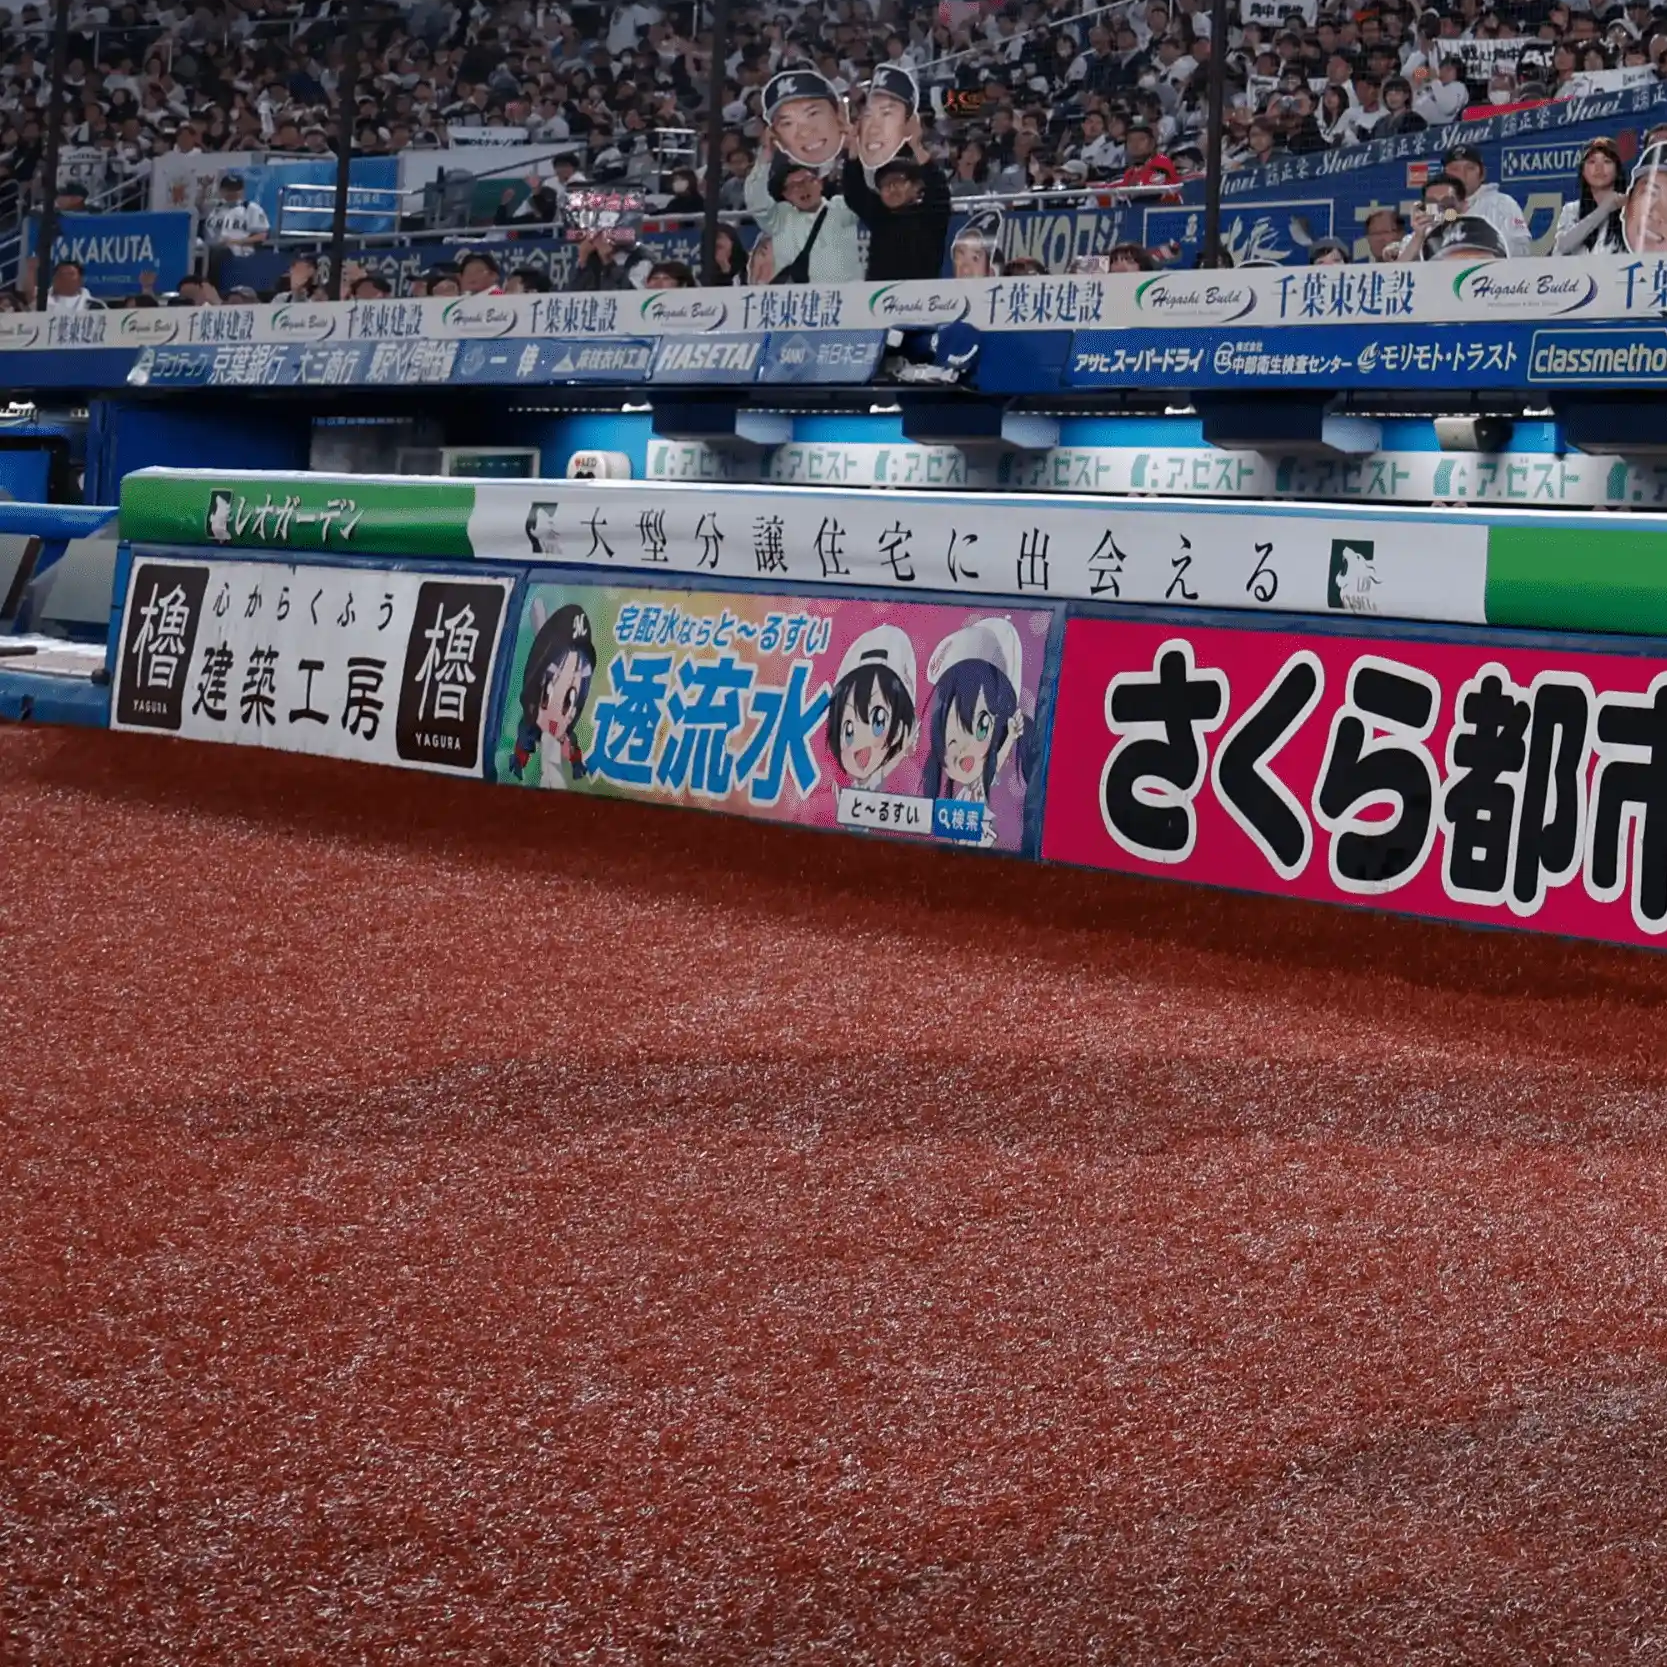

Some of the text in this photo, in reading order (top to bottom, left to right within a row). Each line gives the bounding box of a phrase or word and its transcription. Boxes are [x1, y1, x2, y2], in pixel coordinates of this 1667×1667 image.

[70, 234, 154, 263] KAKUTA
[986, 280, 1105, 325] 千葉東建設
[1150, 284, 1242, 309] Higashi Build
[1272, 269, 1416, 318] 千葉東建設
[1471, 272, 1580, 300] Higashi Build
[739, 288, 843, 330] 千葉東建設
[207, 344, 289, 384] 京葉銀行
[656, 342, 763, 371] HASETAI
[233, 495, 364, 539] レオガーデン
[580, 506, 1279, 604] 大型分譲住宅に出会える
[212, 581, 394, 631] 心からくふう
[132, 698, 168, 716] YAGURA
[191, 645, 388, 742] 建築工房
[414, 733, 463, 752] YAGURA
[585, 654, 832, 806] 透流水
[952, 807, 979, 833] 検索
